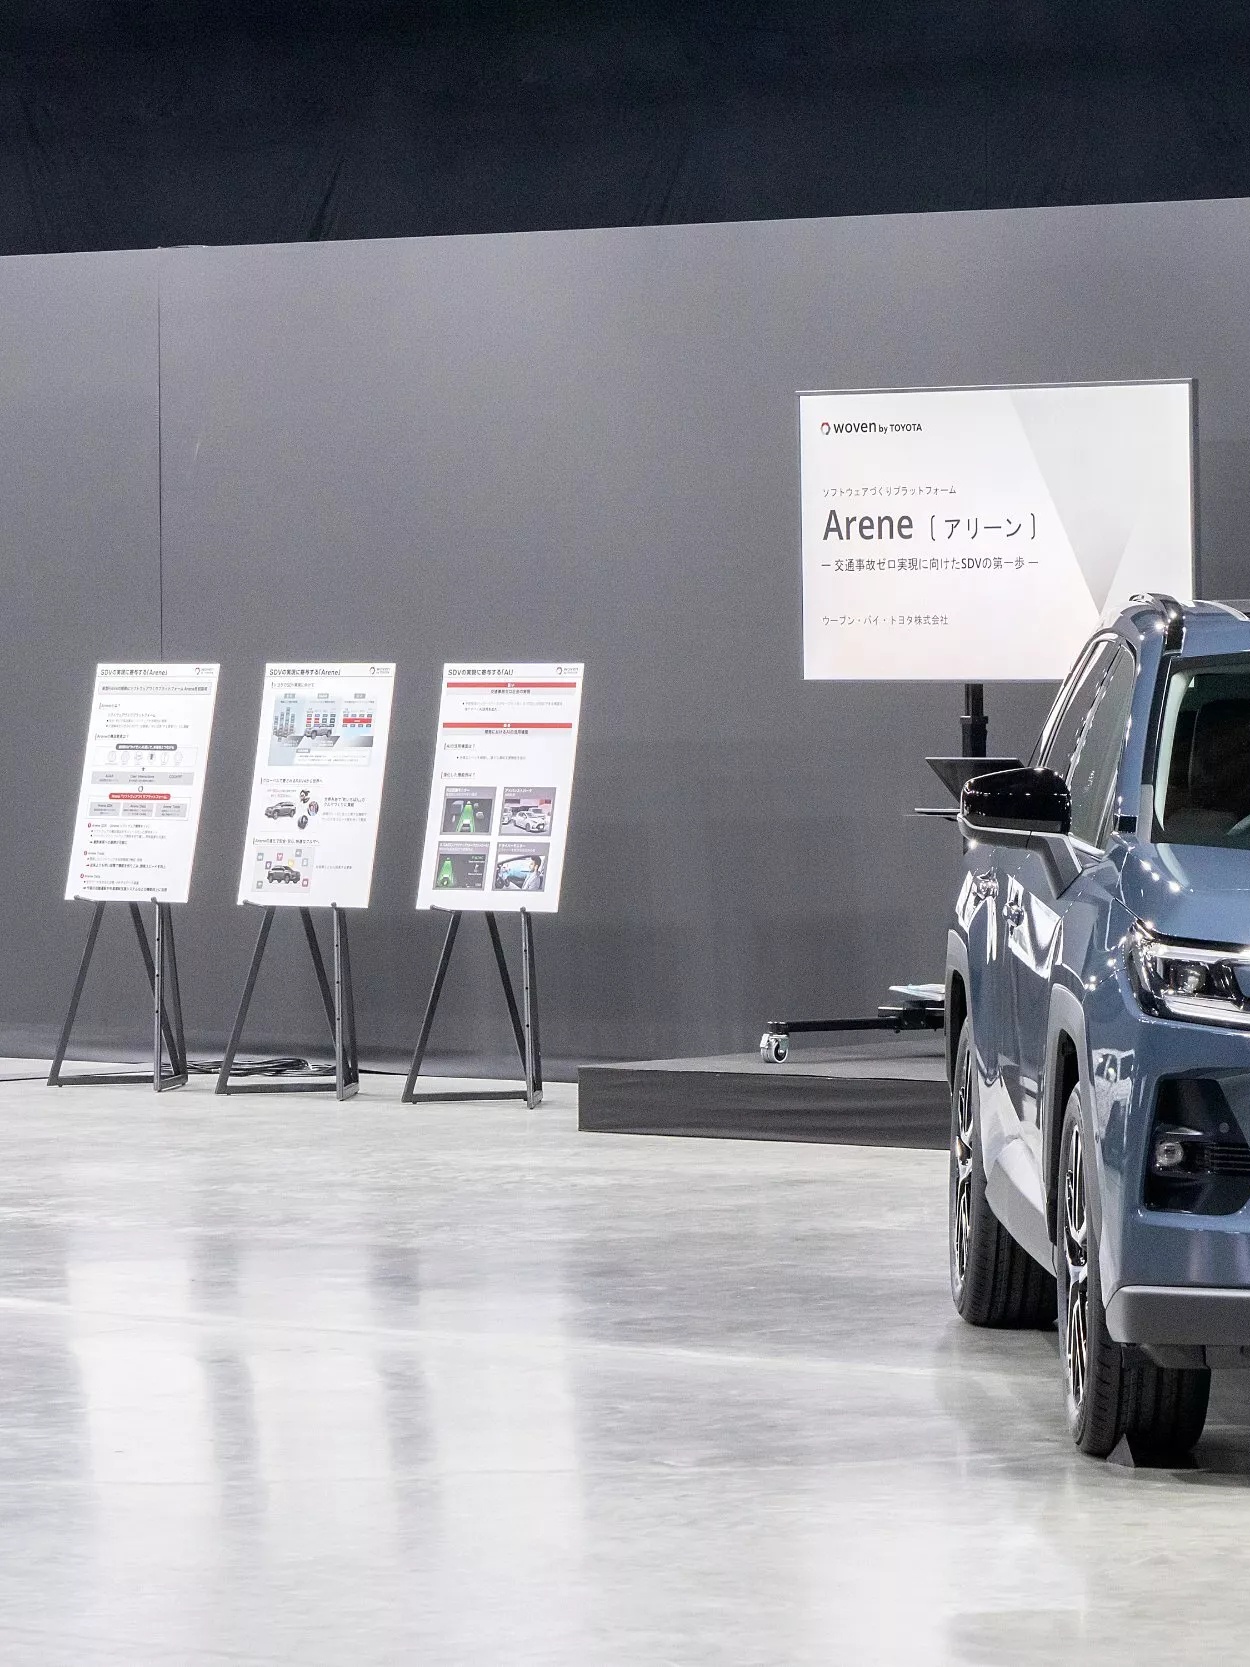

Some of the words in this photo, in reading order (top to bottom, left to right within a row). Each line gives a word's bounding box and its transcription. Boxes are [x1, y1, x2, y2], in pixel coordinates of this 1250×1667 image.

[833, 422, 877, 434] woven
[879, 425, 888, 434] by
[890, 424, 922, 432] TOYOTA
[823, 486, 957, 498] ソフトウェアづくりプラットフォーム
[822, 509, 914, 541] Arene
[822, 614, 949, 626] ウーブン・バイ・トヨタ株式会社
